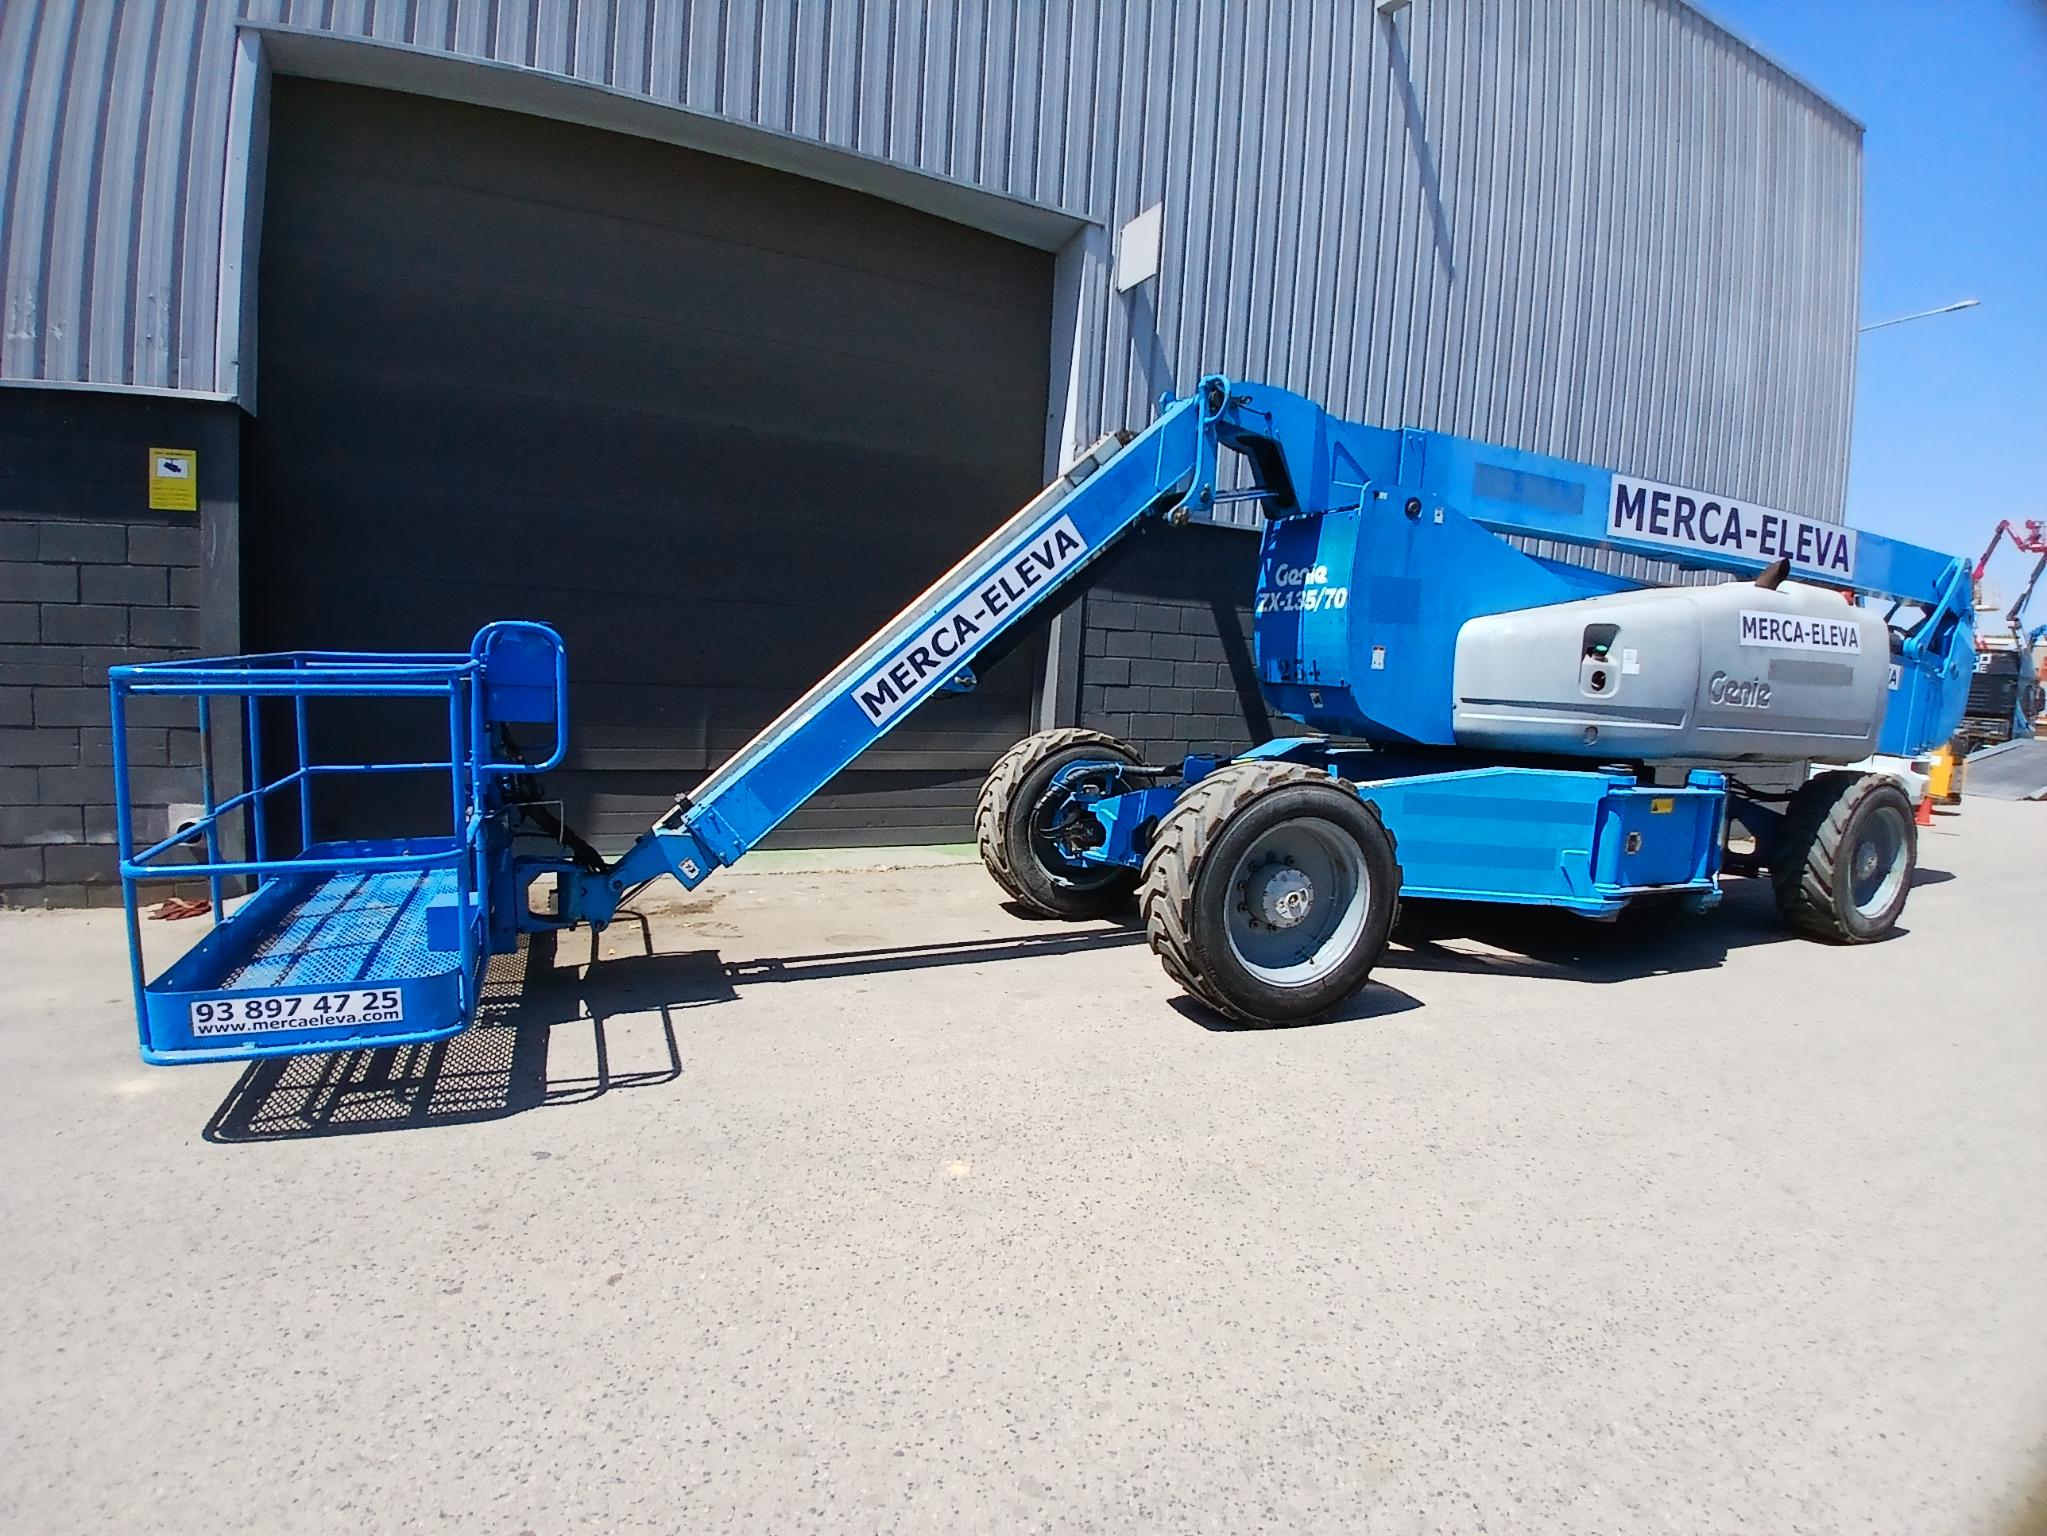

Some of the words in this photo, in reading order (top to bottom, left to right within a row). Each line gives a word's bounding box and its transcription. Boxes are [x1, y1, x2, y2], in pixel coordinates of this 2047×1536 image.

[1614, 483, 1849, 572] MERCA-ELEVA
[1275, 562, 1329, 587] Genie
[1256, 586, 1349, 613] ZX-135/70
[860, 529, 1080, 718] MERCA-ELEVA
[1742, 616, 1858, 648] MERCA-ELEVA
[1709, 671, 1771, 708] Genie
[195, 1002, 234, 1023] 93
[245, 998, 302, 1019] 897
[313, 994, 351, 1014] 47
[362, 991, 398, 1011] 25
[198, 1010, 400, 1034] www.mercaeleva.com
